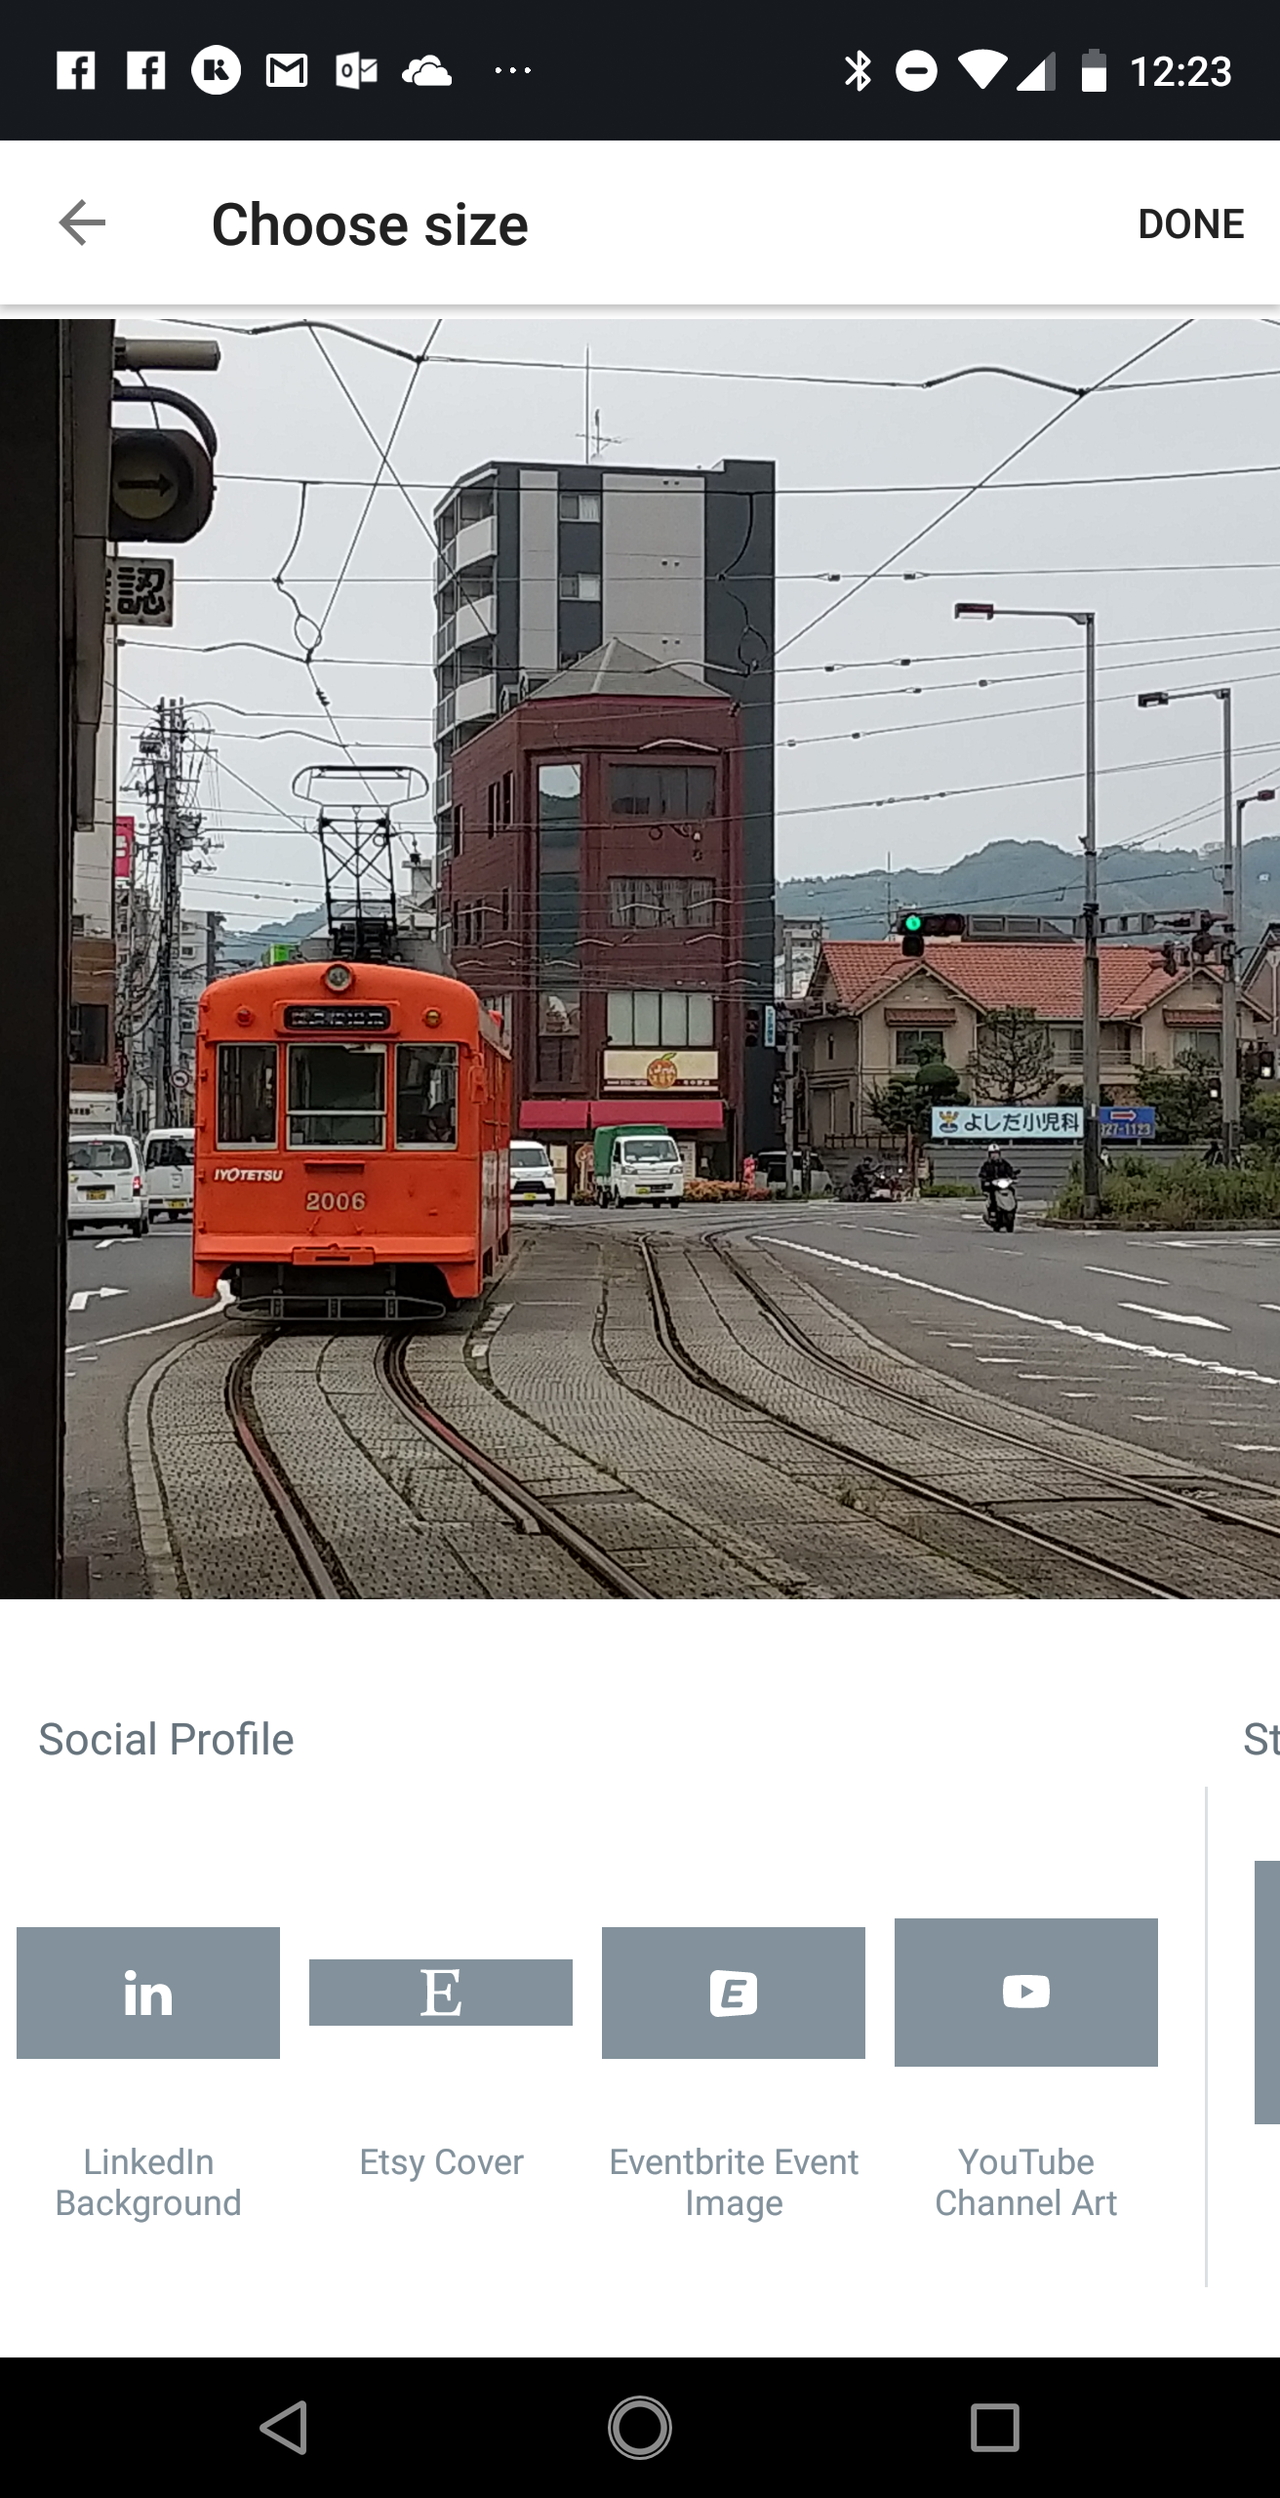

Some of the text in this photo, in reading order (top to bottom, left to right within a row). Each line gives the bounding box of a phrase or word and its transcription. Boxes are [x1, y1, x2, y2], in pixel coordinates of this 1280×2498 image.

[1130, 55, 1232, 88] 12:23
[212, 200, 529, 247] Choose size
[1139, 207, 1245, 240] DONE
[964, 1112, 1079, 1133] よしだ小児科
[213, 1167, 284, 1182] IYOTETSU
[306, 1192, 366, 1211] 2006
[38, 1718, 295, 1757] Social Profile
[123, 1969, 173, 2016] in
[419, 1968, 463, 2017] E
[84, 2146, 214, 2176] LinkedIn
[361, 2147, 525, 2183] Etsy Cover
[610, 2146, 860, 2176] Eventbrite Event
[957, 2146, 1095, 2176] YouTube
[56, 2187, 241, 2223] Background
[687, 2188, 784, 2223] Image
[935, 2187, 1118, 2217] Channel Art
